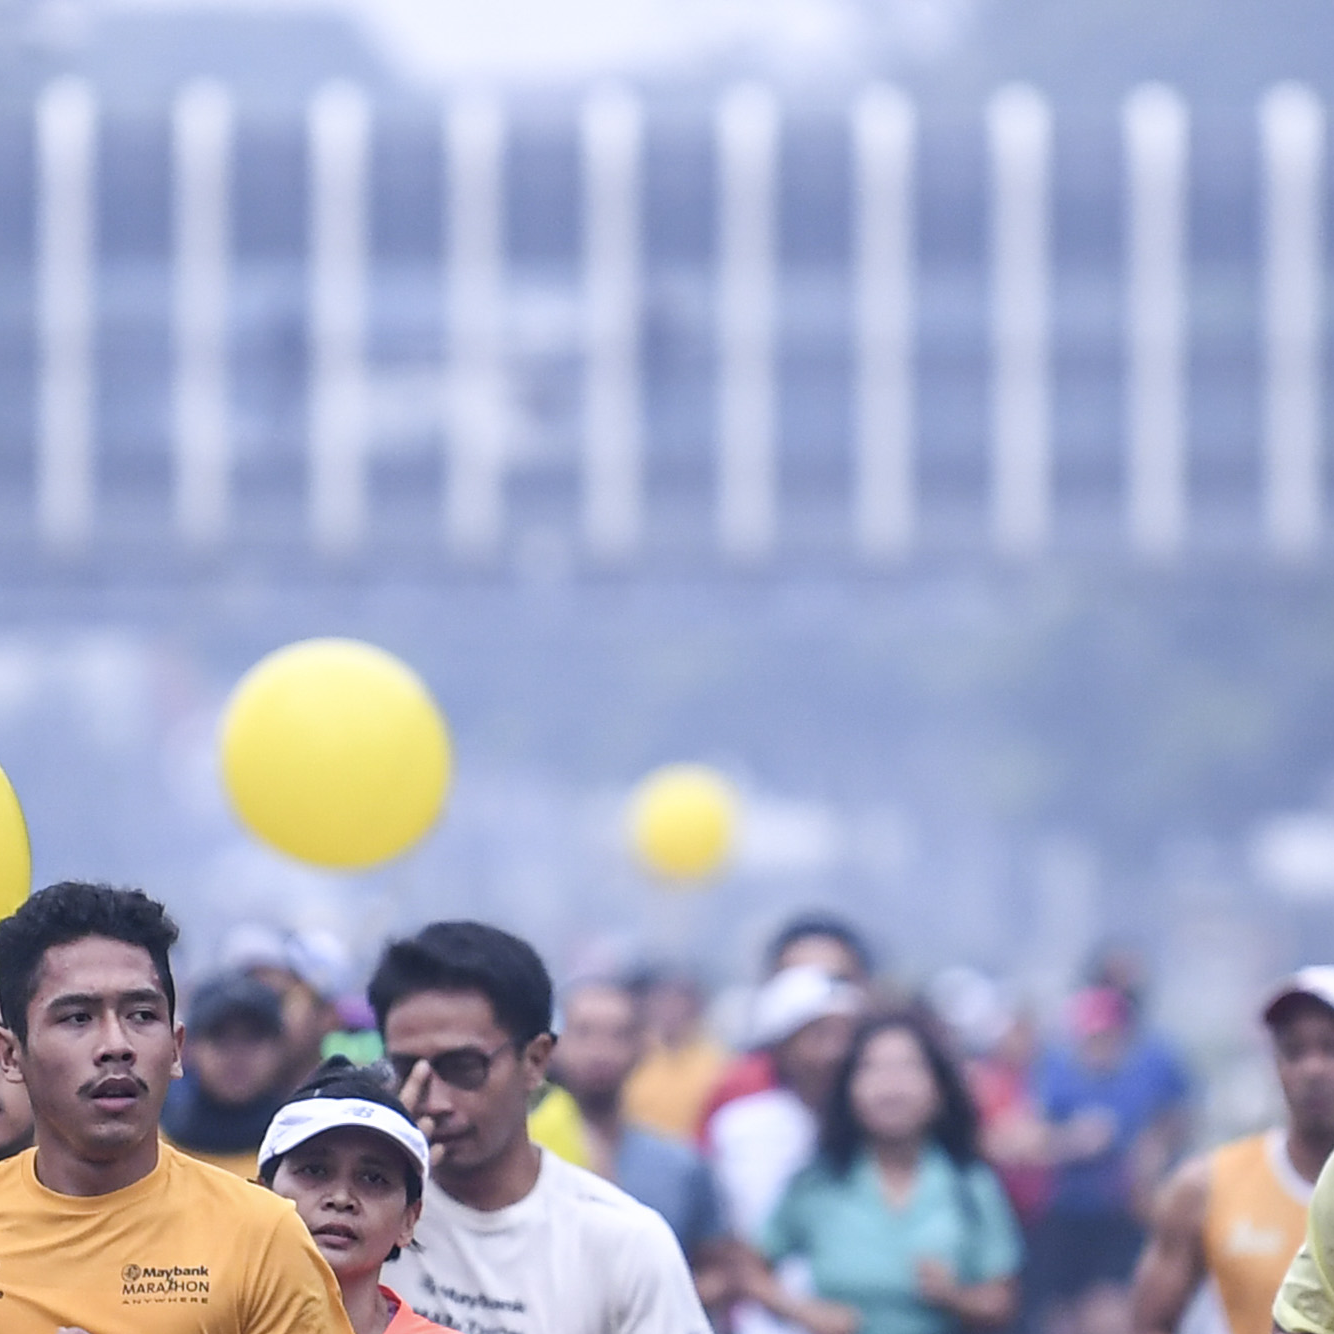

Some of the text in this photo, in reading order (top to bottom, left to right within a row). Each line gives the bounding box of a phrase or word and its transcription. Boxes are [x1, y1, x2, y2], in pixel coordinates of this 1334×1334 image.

[142, 1264, 209, 1281] Maybank
[122, 1280, 210, 1296] MARATHON
[122, 1296, 209, 1305] ANYWHERE
